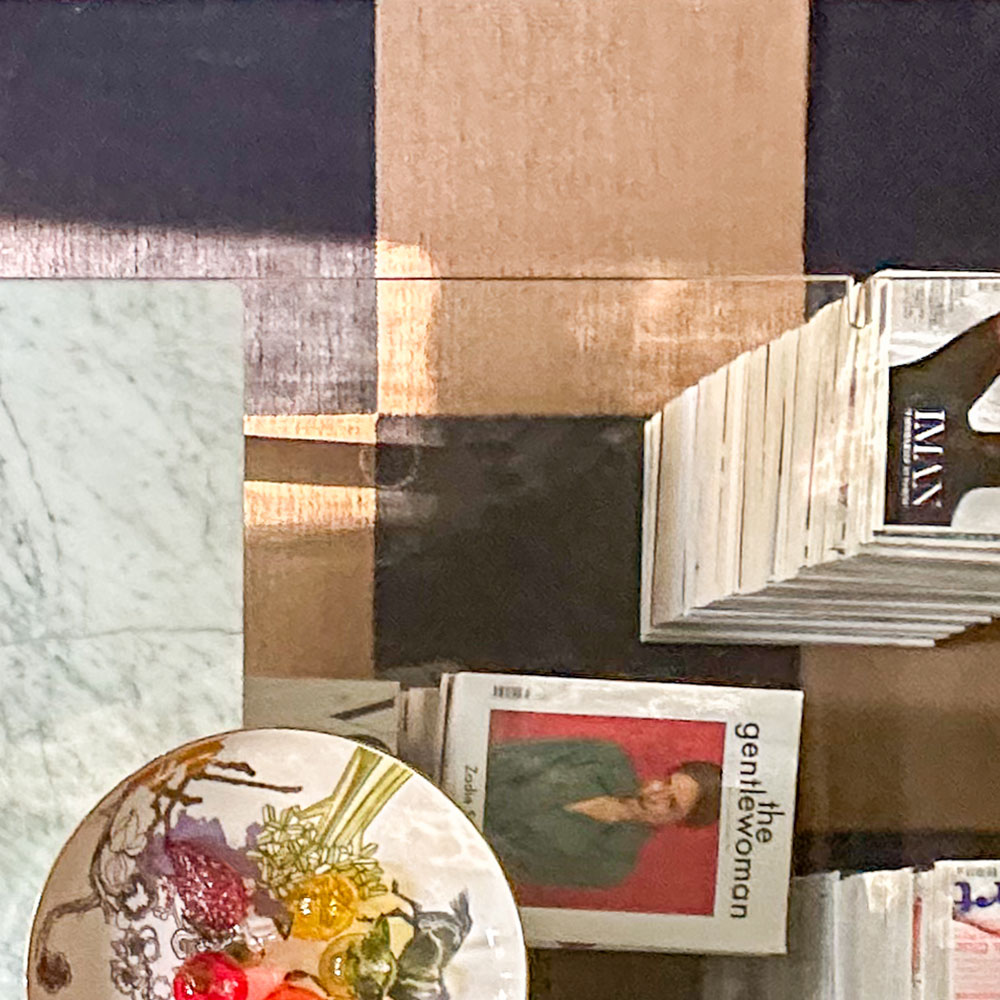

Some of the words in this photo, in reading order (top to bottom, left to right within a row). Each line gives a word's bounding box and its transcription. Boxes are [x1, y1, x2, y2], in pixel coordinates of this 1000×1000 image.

[912, 409, 946, 509] IMAN
[729, 722, 767, 920] gentlewoman
[755, 801, 786, 844] the
